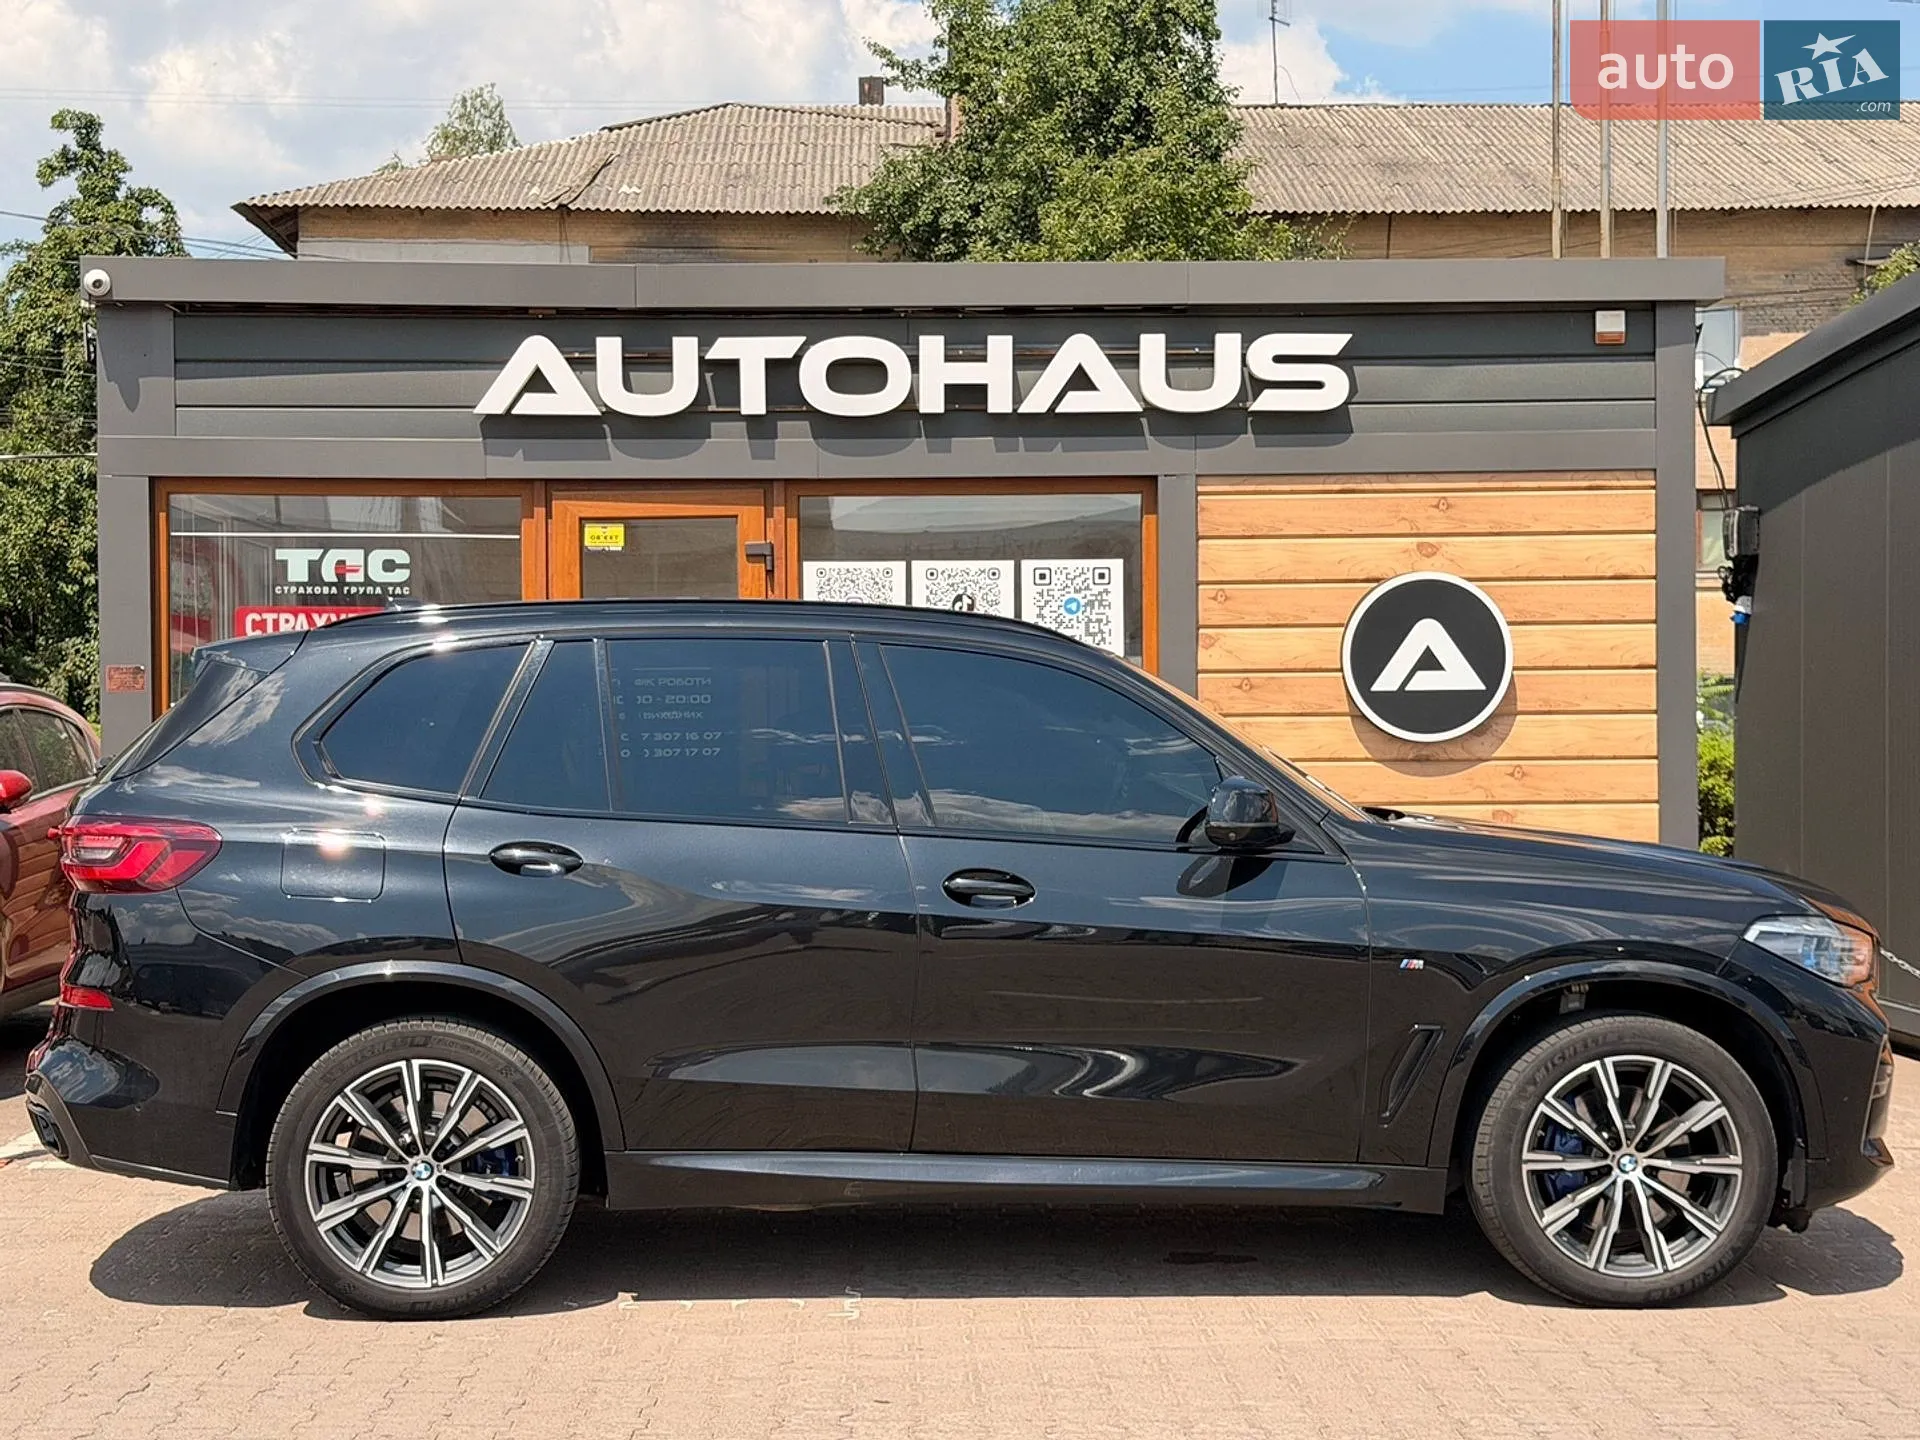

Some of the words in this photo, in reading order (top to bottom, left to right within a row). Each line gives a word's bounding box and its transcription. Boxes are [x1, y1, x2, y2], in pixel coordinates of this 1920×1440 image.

[473, 332, 1353, 418] AUTOHAUS
[275, 585, 338, 595] СТРАХОВА
[343, 585, 382, 595] ГРУПА
[387, 585, 410, 595] ТАС
[245, 612, 359, 637] СТРАХ
[665, 694, 711, 704] 20:00
[653, 732, 682, 741] 307
[703, 731, 722, 740] 07
[685, 748, 698, 756] 17
[702, 747, 720, 756] 07
